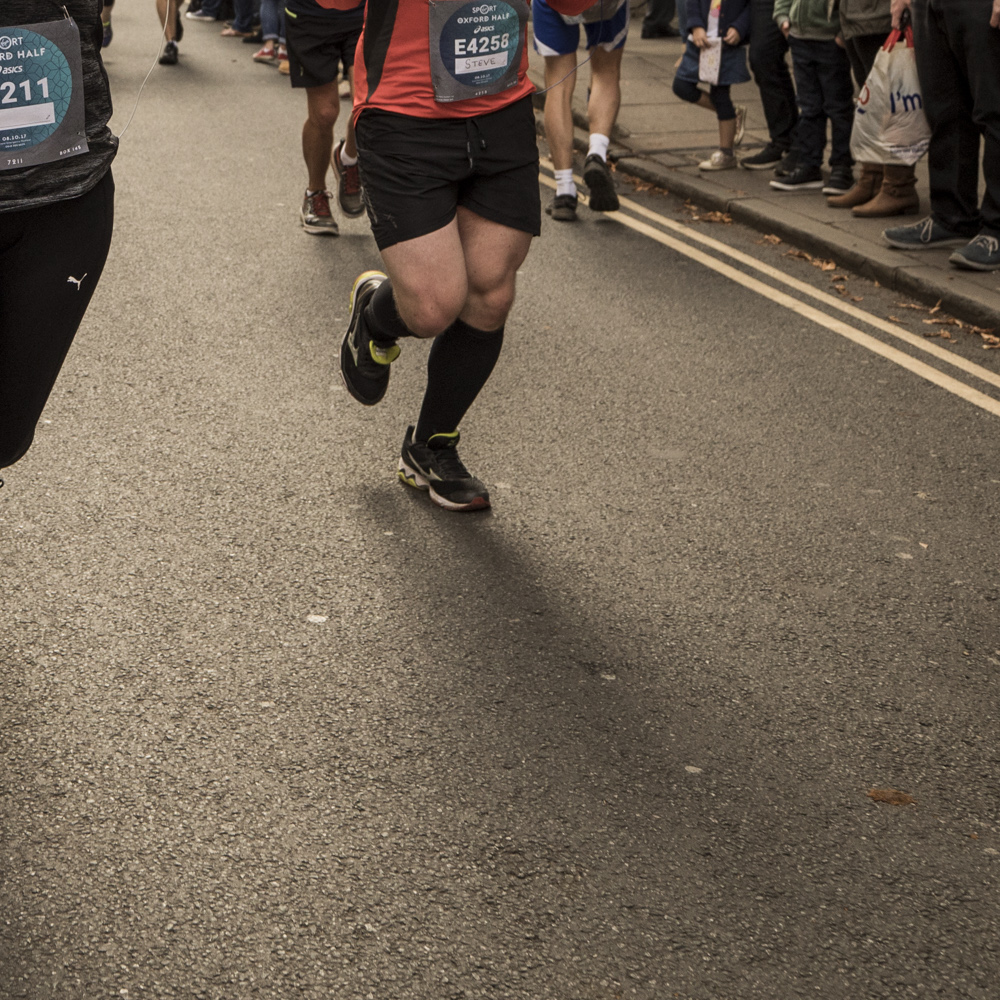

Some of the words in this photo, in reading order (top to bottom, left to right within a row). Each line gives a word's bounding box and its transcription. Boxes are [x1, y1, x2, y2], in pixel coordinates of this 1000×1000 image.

[472, 4, 496, 14] SPORT
[457, 16, 489, 24] OXFORD
[455, 33, 509, 55] E4258
[17, 48, 46, 58] HALF
[465, 58, 496, 69] STEVE
[2, 65, 22, 74] asics
[890, 90, 922, 114] I'm
